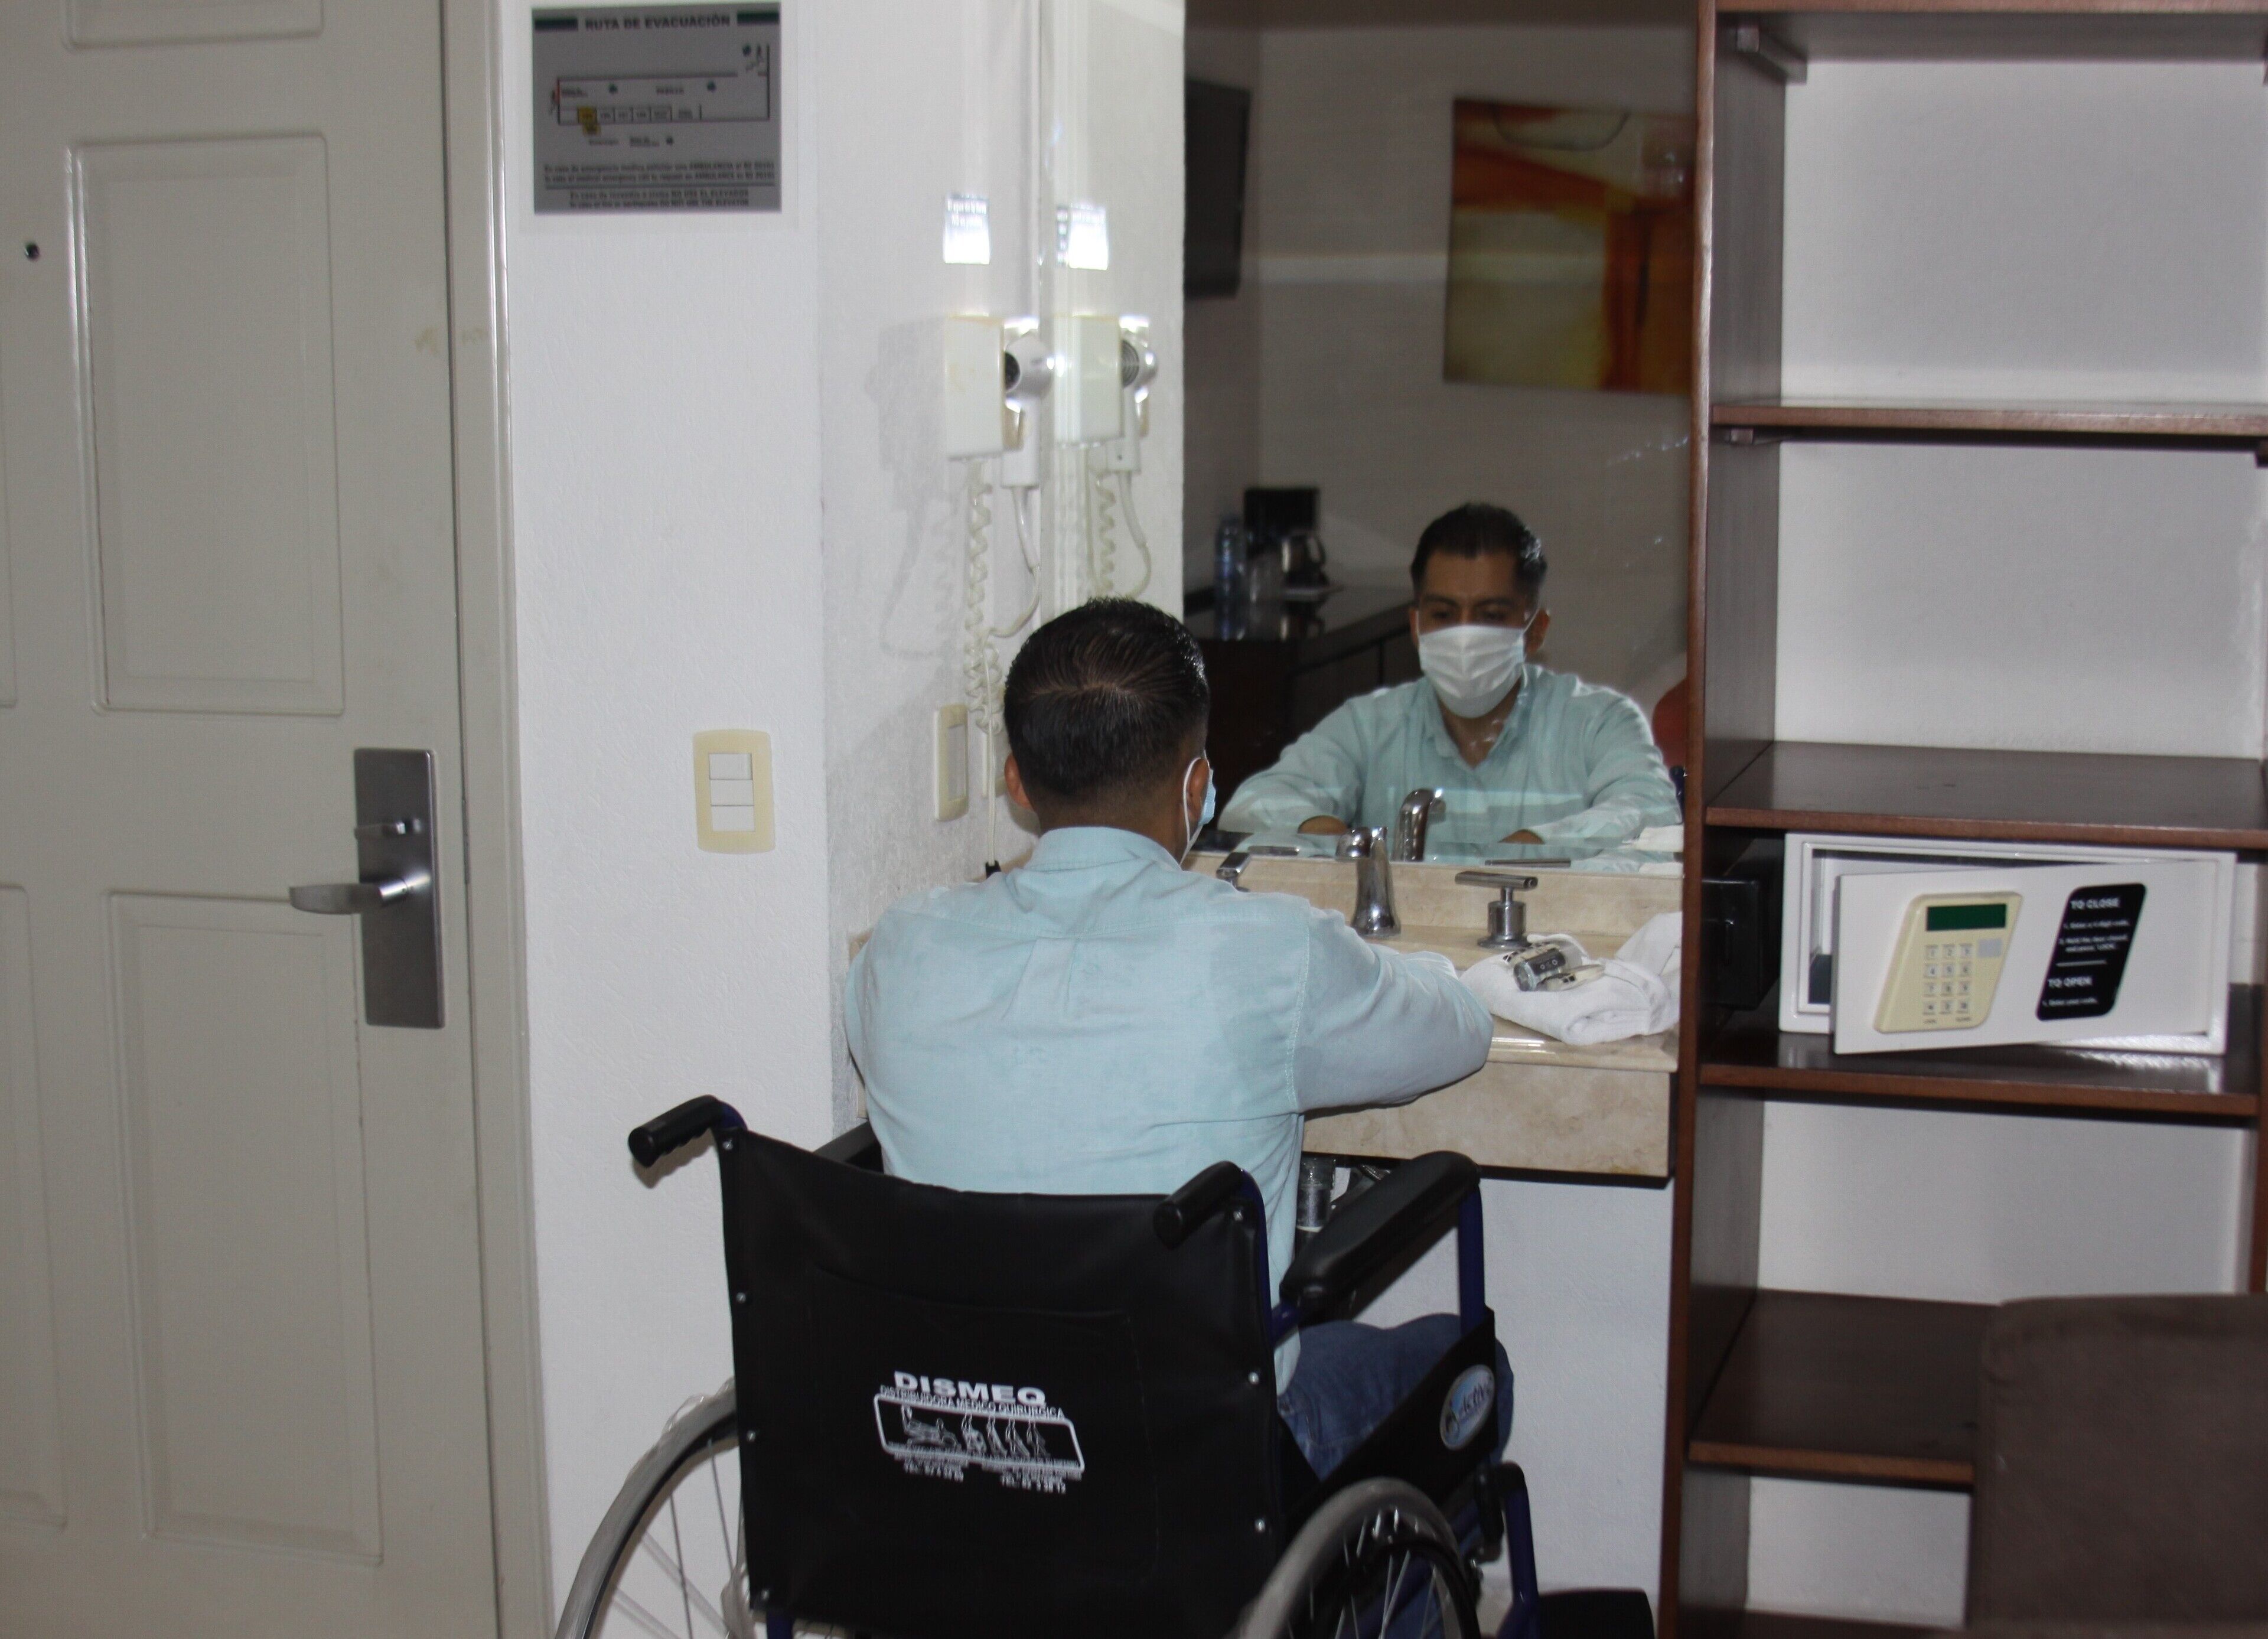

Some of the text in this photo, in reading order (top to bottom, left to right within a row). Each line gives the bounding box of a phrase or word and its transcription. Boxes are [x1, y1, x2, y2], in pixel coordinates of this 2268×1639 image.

[585, 13, 730, 30] RUTA DE EVACUACIÓN
[2070, 897, 2121, 910] TO CLOSE
[2048, 976, 2092, 988] TO OPEN
[894, 1370, 1046, 1407] DISMEQ
